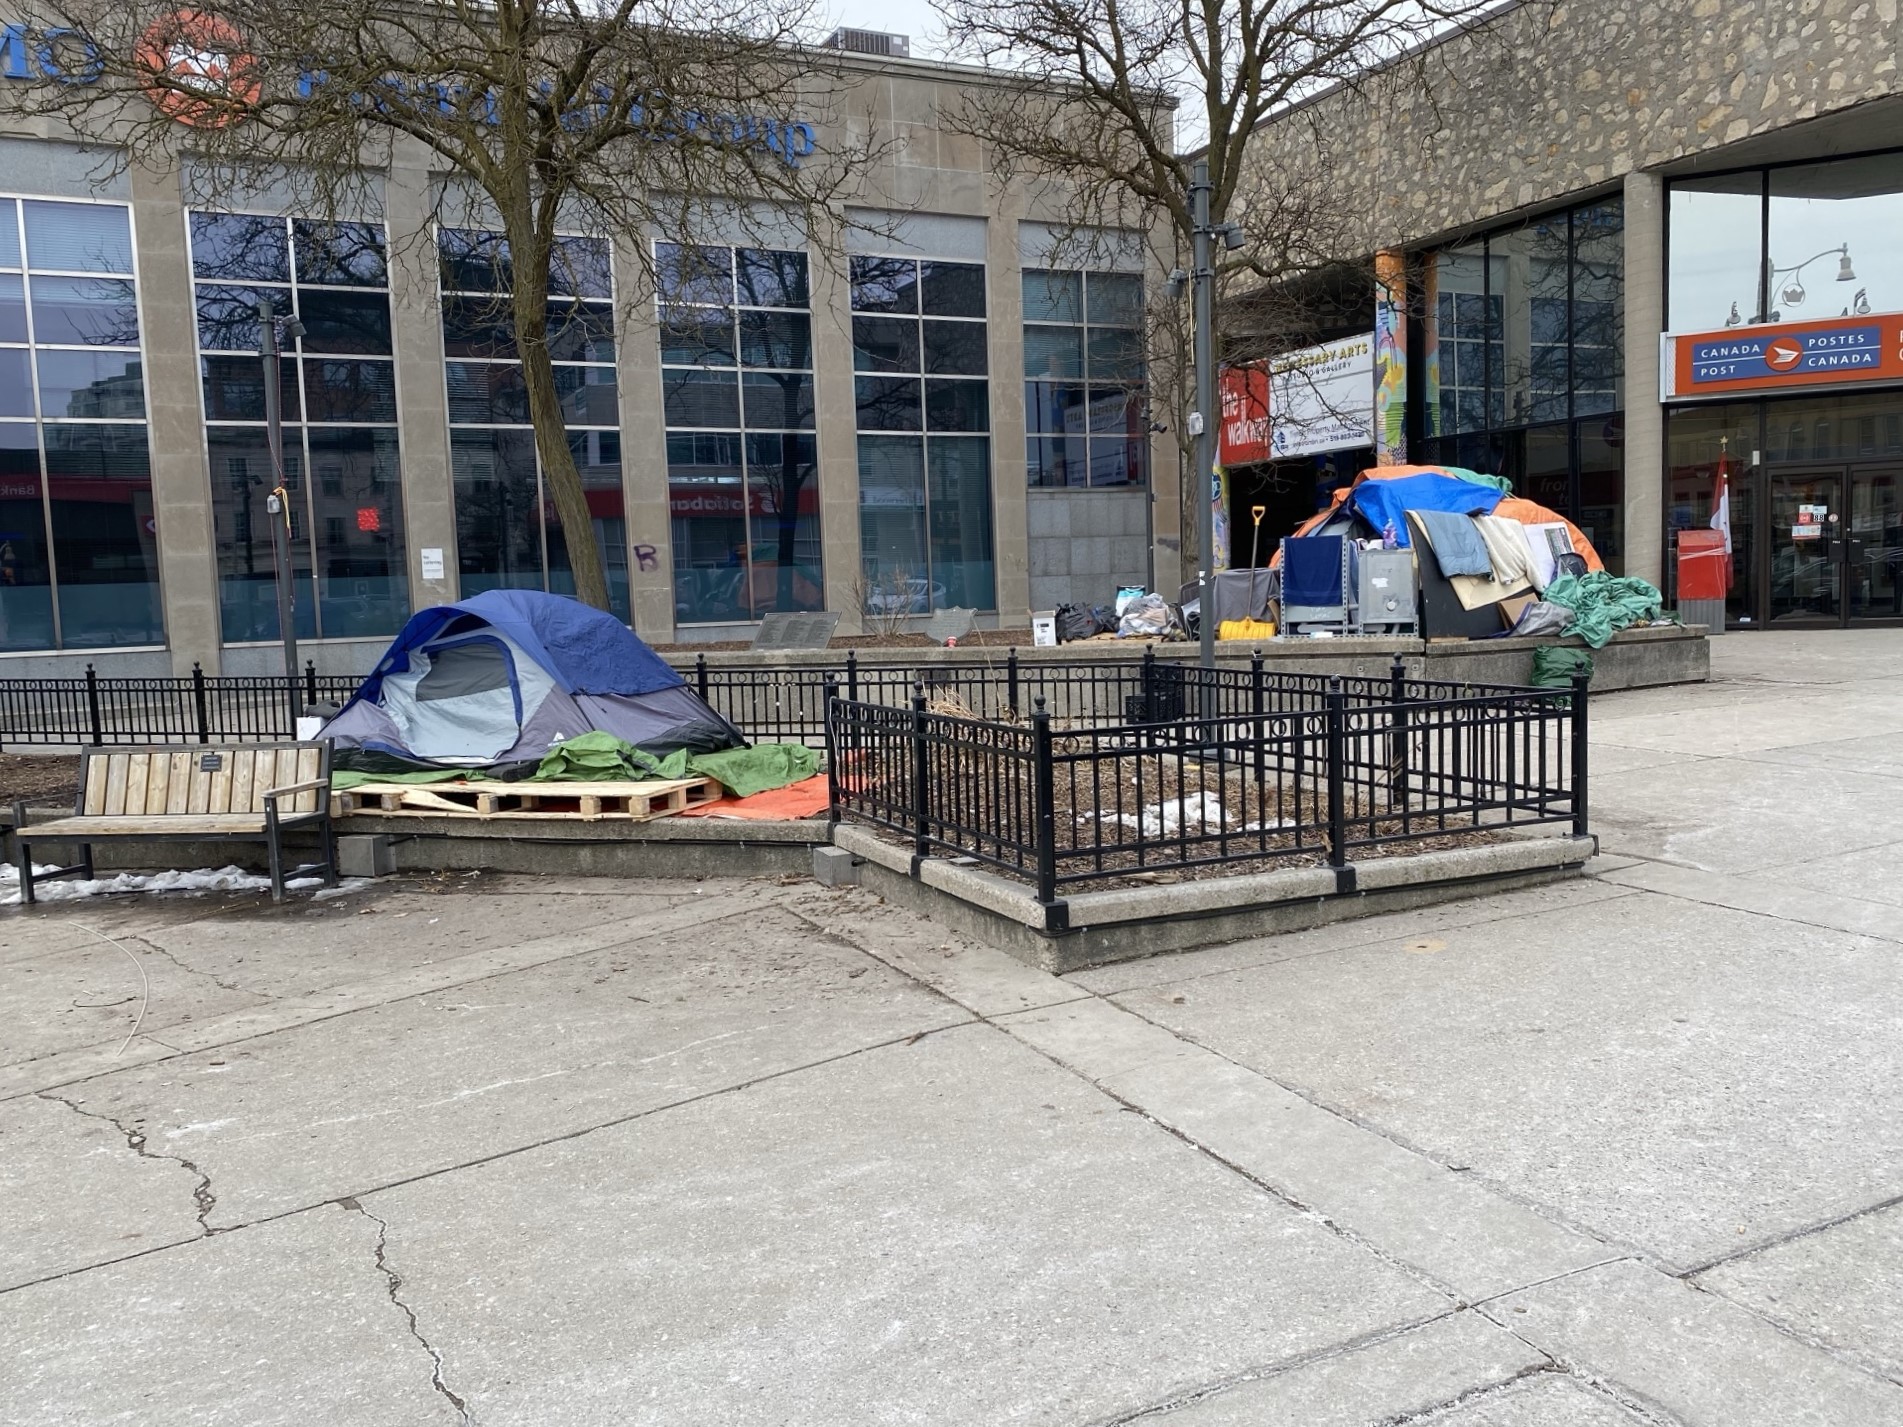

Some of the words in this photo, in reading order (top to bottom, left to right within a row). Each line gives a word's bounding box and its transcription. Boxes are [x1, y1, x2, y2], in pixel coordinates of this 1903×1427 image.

[1808, 334, 1865, 348] POSTES
[1339, 341, 1368, 359] ARTS
[1700, 344, 1761, 358] CANADA
[1808, 353, 1872, 367] CANADA
[1700, 365, 1736, 377] POST
